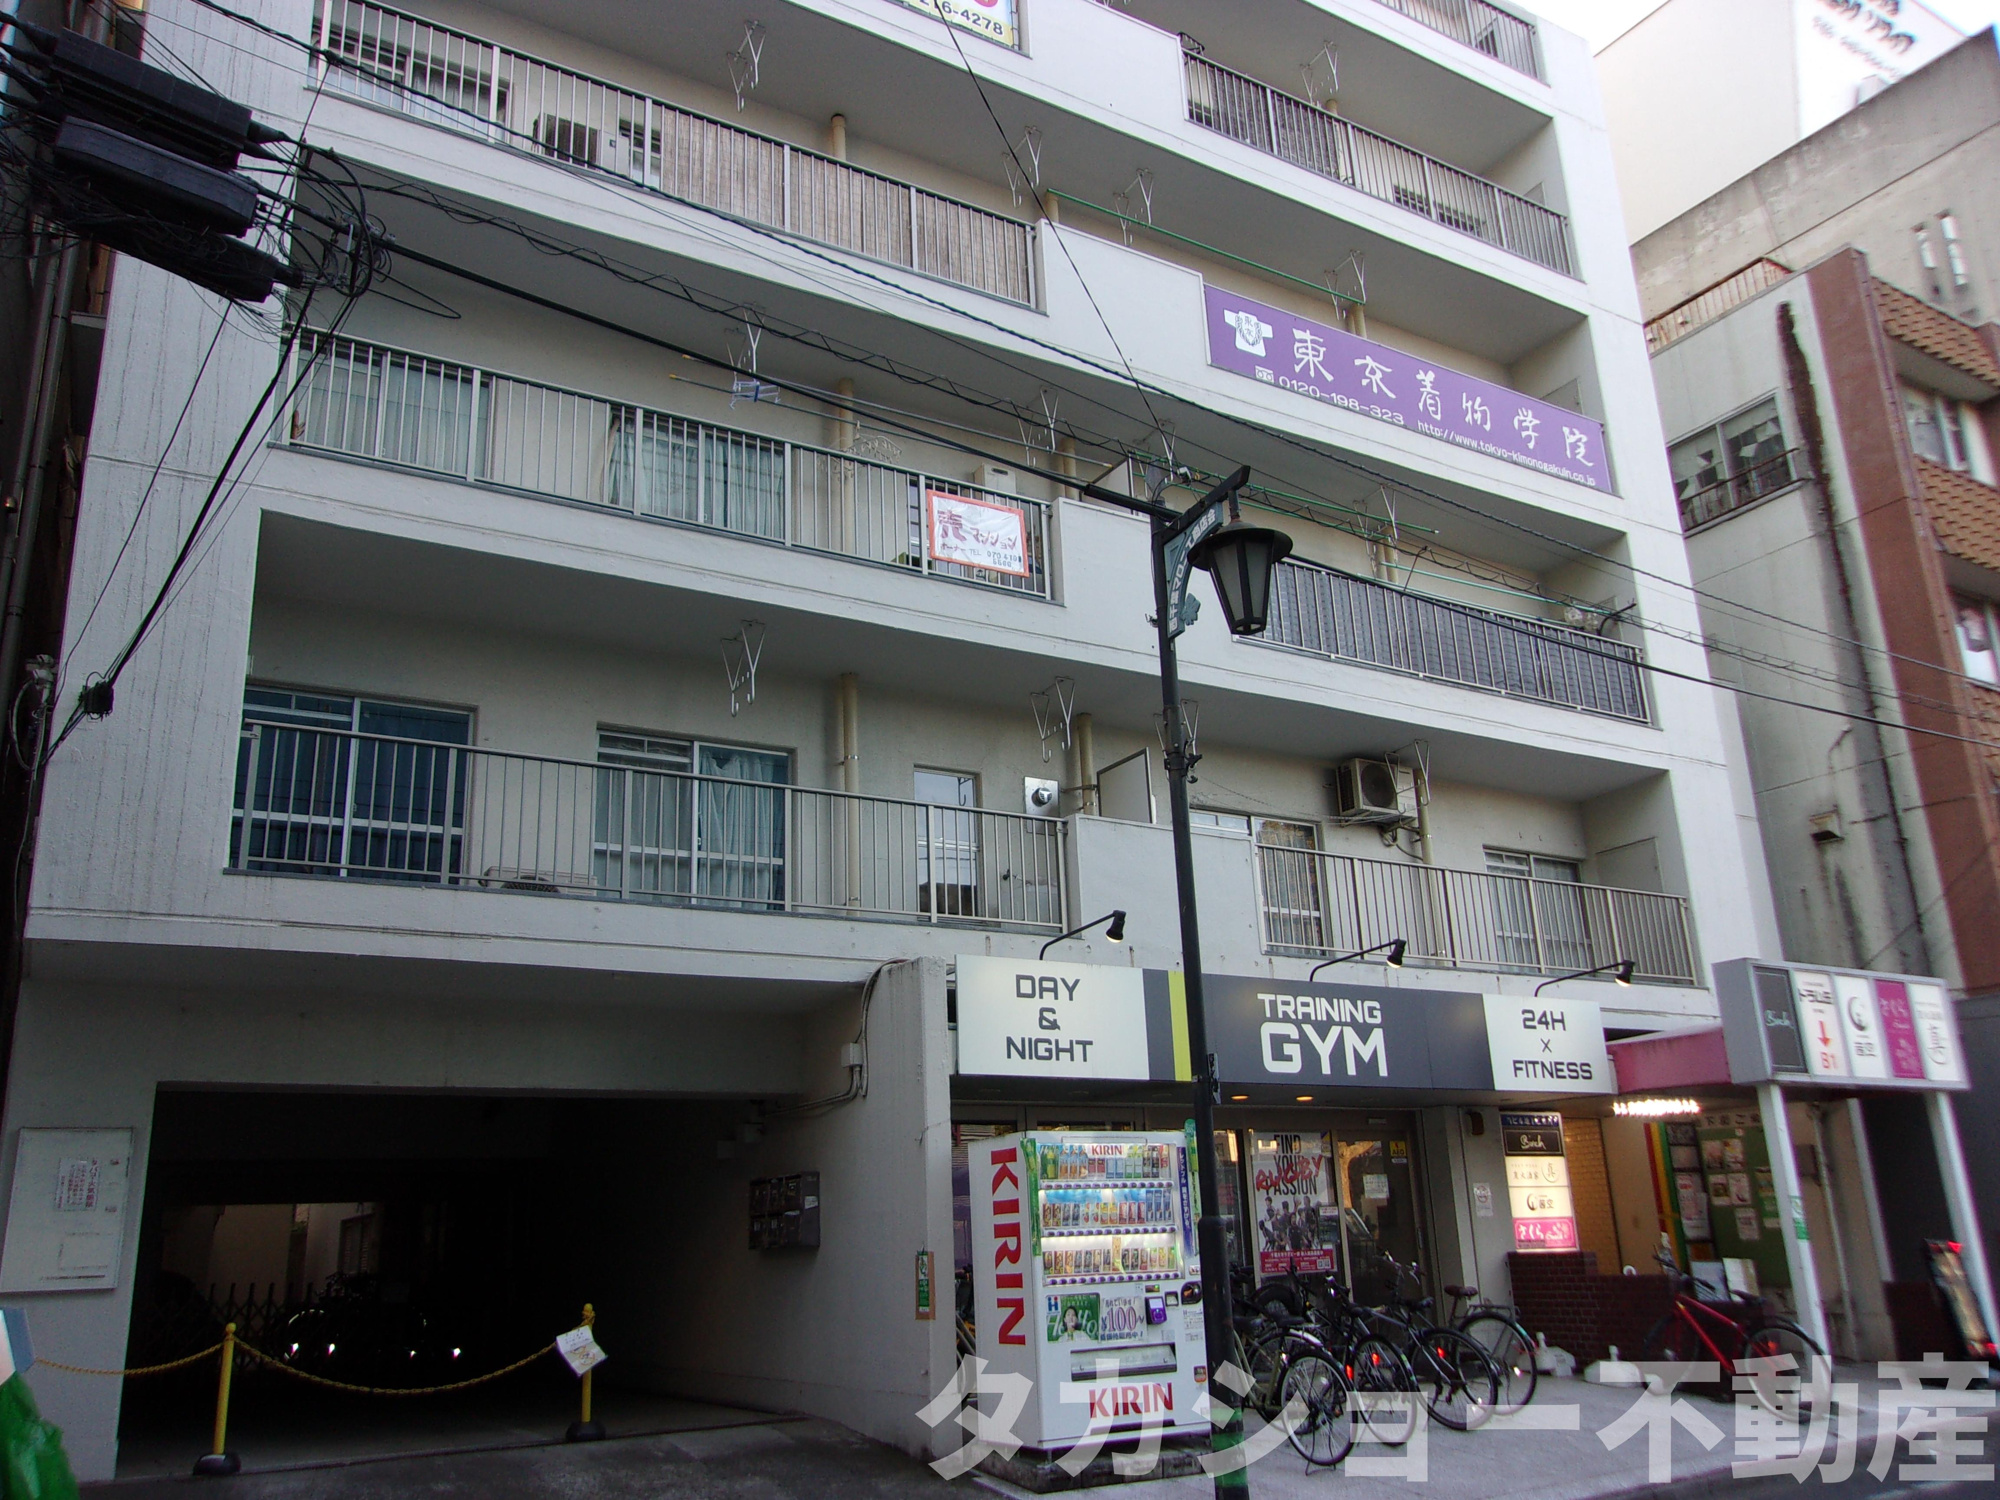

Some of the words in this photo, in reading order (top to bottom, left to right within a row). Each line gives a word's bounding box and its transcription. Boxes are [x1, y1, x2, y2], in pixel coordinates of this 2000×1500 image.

[1279, 375, 1405, 425] 0120-198-323
[1293, 328, 1594, 467] 東京着物学院
[1016, 974, 1081, 1001] DAY
[1038, 1007, 1061, 1030] &
[1257, 993, 1382, 1025] TRAINING
[1521, 1009, 1567, 1032] 24H
[1006, 1036, 1094, 1062] NIGHT
[1260, 1021, 1389, 1077] GYM
[1821, 1051, 1838, 1069] B1
[1512, 1059, 1593, 1081] FITNESS
[1091, 1144, 1123, 1156] KIRIN
[1273, 1134, 1302, 1155] FIND
[1255, 1154, 1324, 1192] RUGBY
[1264, 1174, 1318, 1196] PASSION
[990, 1147, 1026, 1346] KIRIN
[1089, 1382, 1174, 1419] KIRIN
